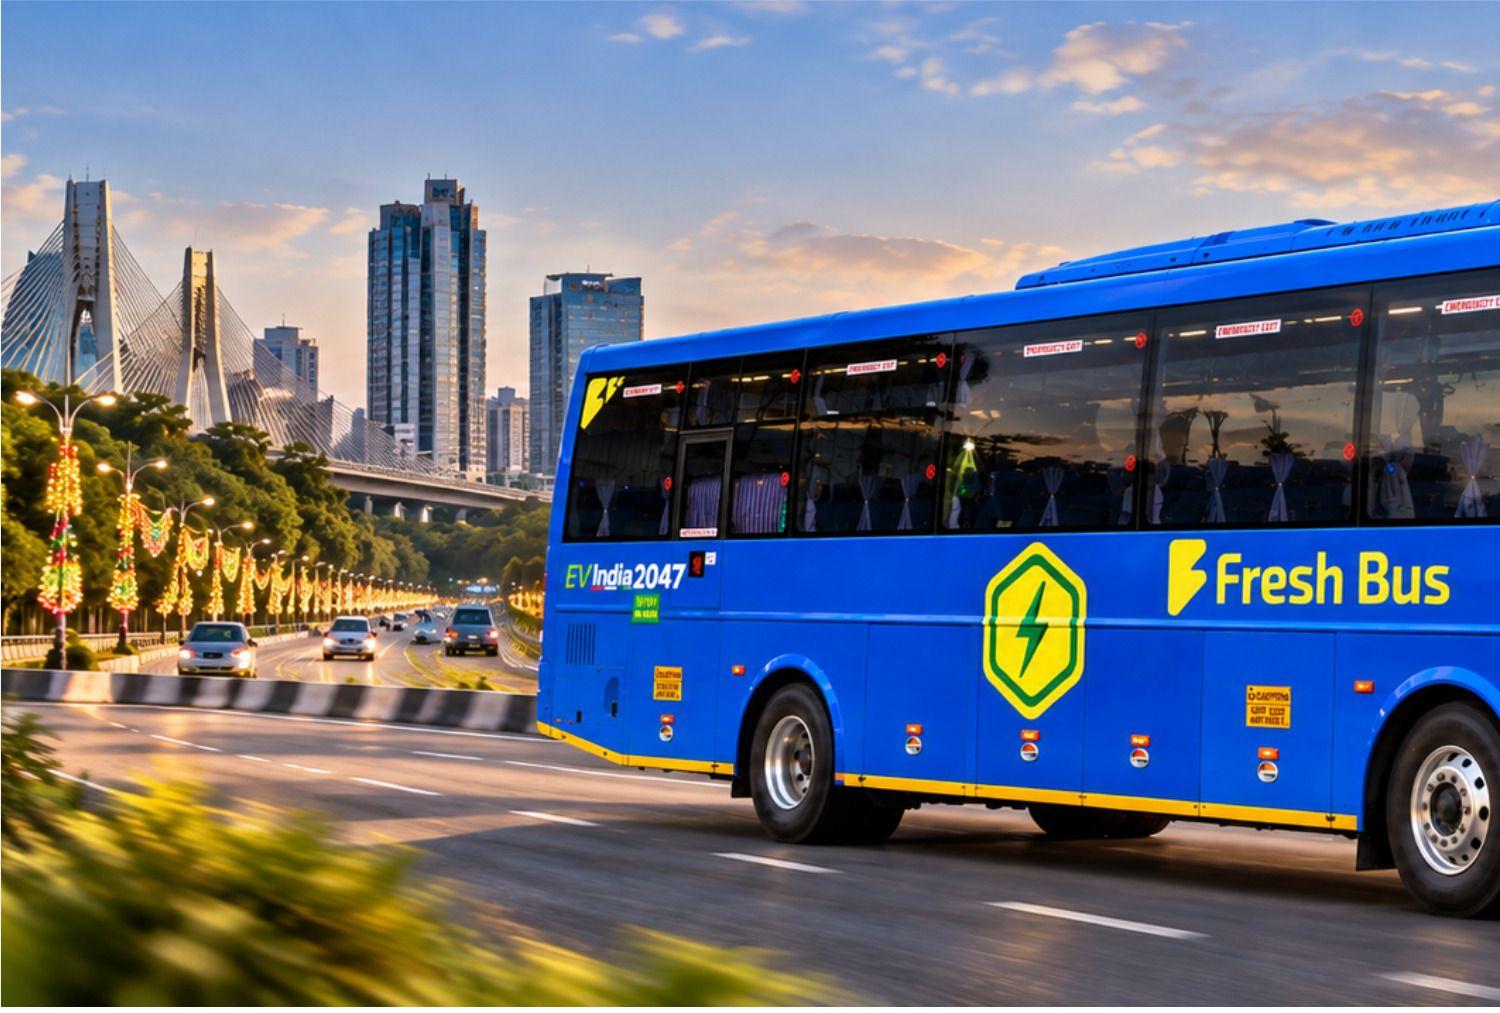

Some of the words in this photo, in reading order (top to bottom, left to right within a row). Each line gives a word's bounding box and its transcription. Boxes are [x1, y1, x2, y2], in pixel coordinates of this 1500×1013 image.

[565, 563, 592, 588] EV
[592, 563, 633, 586] India
[632, 563, 686, 589] 2047
[1216, 551, 1343, 605] Fresh
[1358, 551, 1450, 605] Bus
